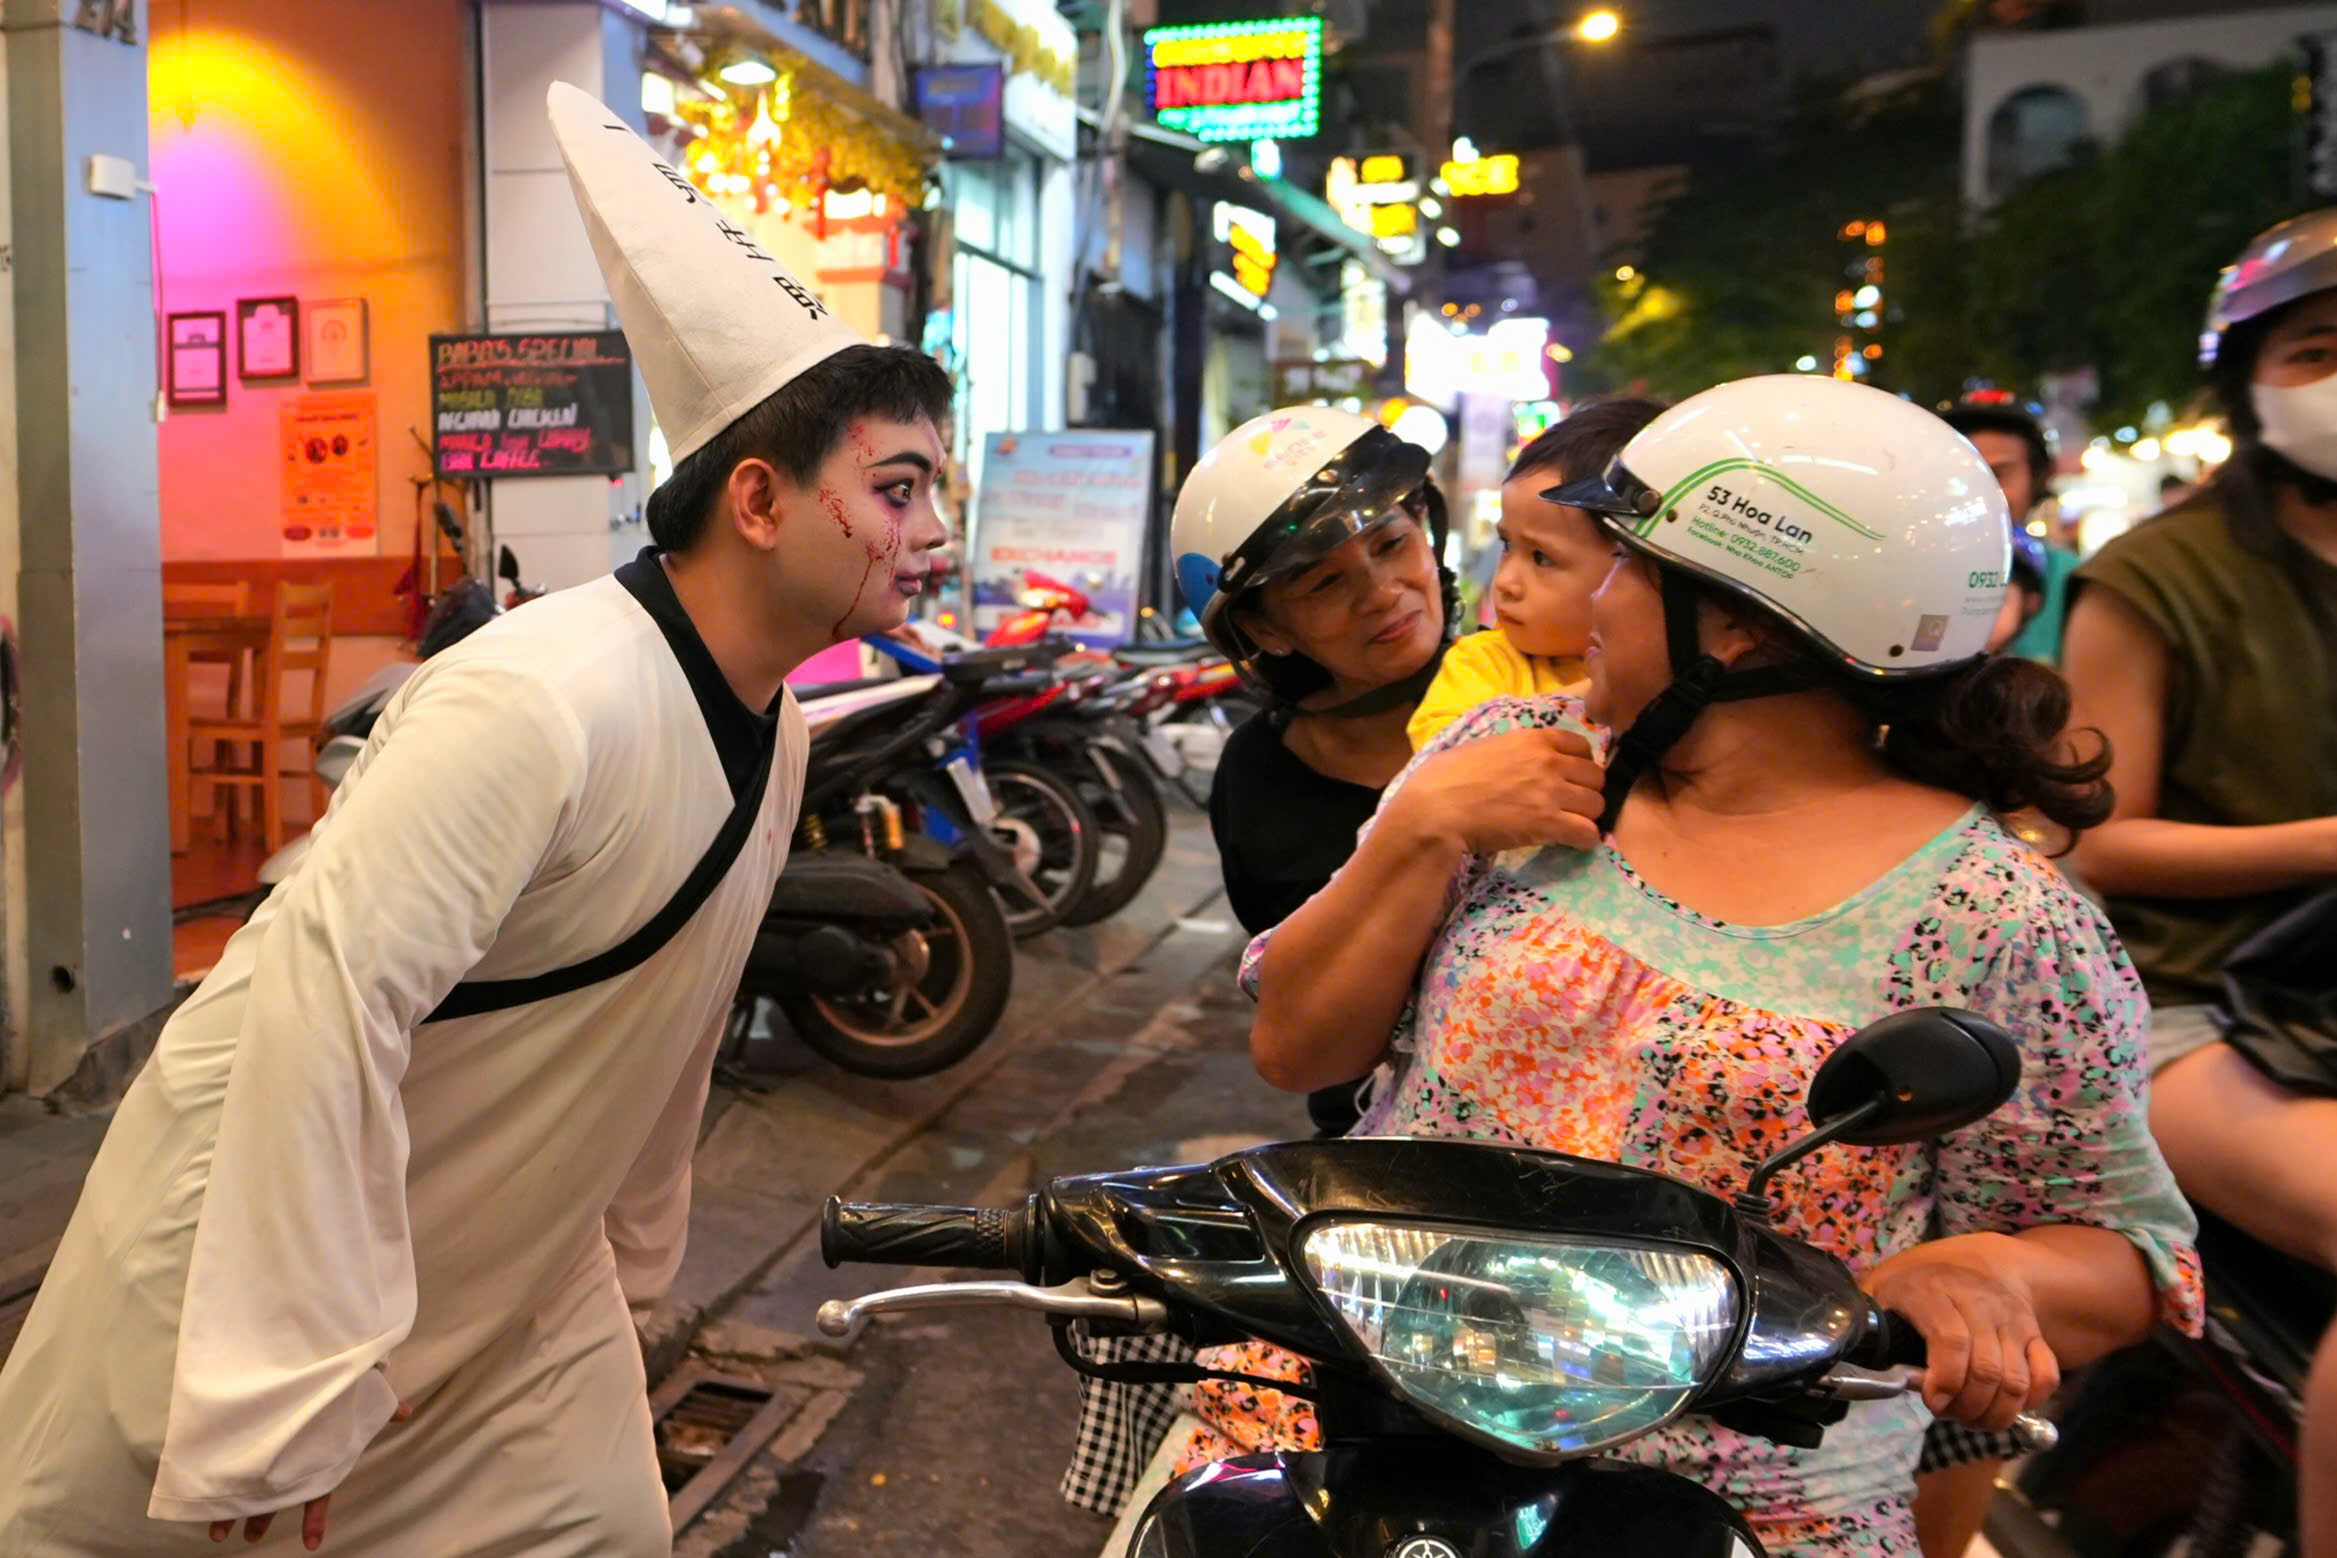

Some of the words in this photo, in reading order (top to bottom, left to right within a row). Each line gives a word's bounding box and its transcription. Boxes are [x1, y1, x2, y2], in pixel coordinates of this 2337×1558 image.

[1154, 58, 1304, 109] INDIAN
[1707, 486, 1732, 506] 53
[1731, 496, 1772, 525] Hoa
[1774, 515, 1812, 544] Lan
[991, 547, 1117, 564] EXCHANGE
[1730, 534, 1801, 572] 0932.887.600
